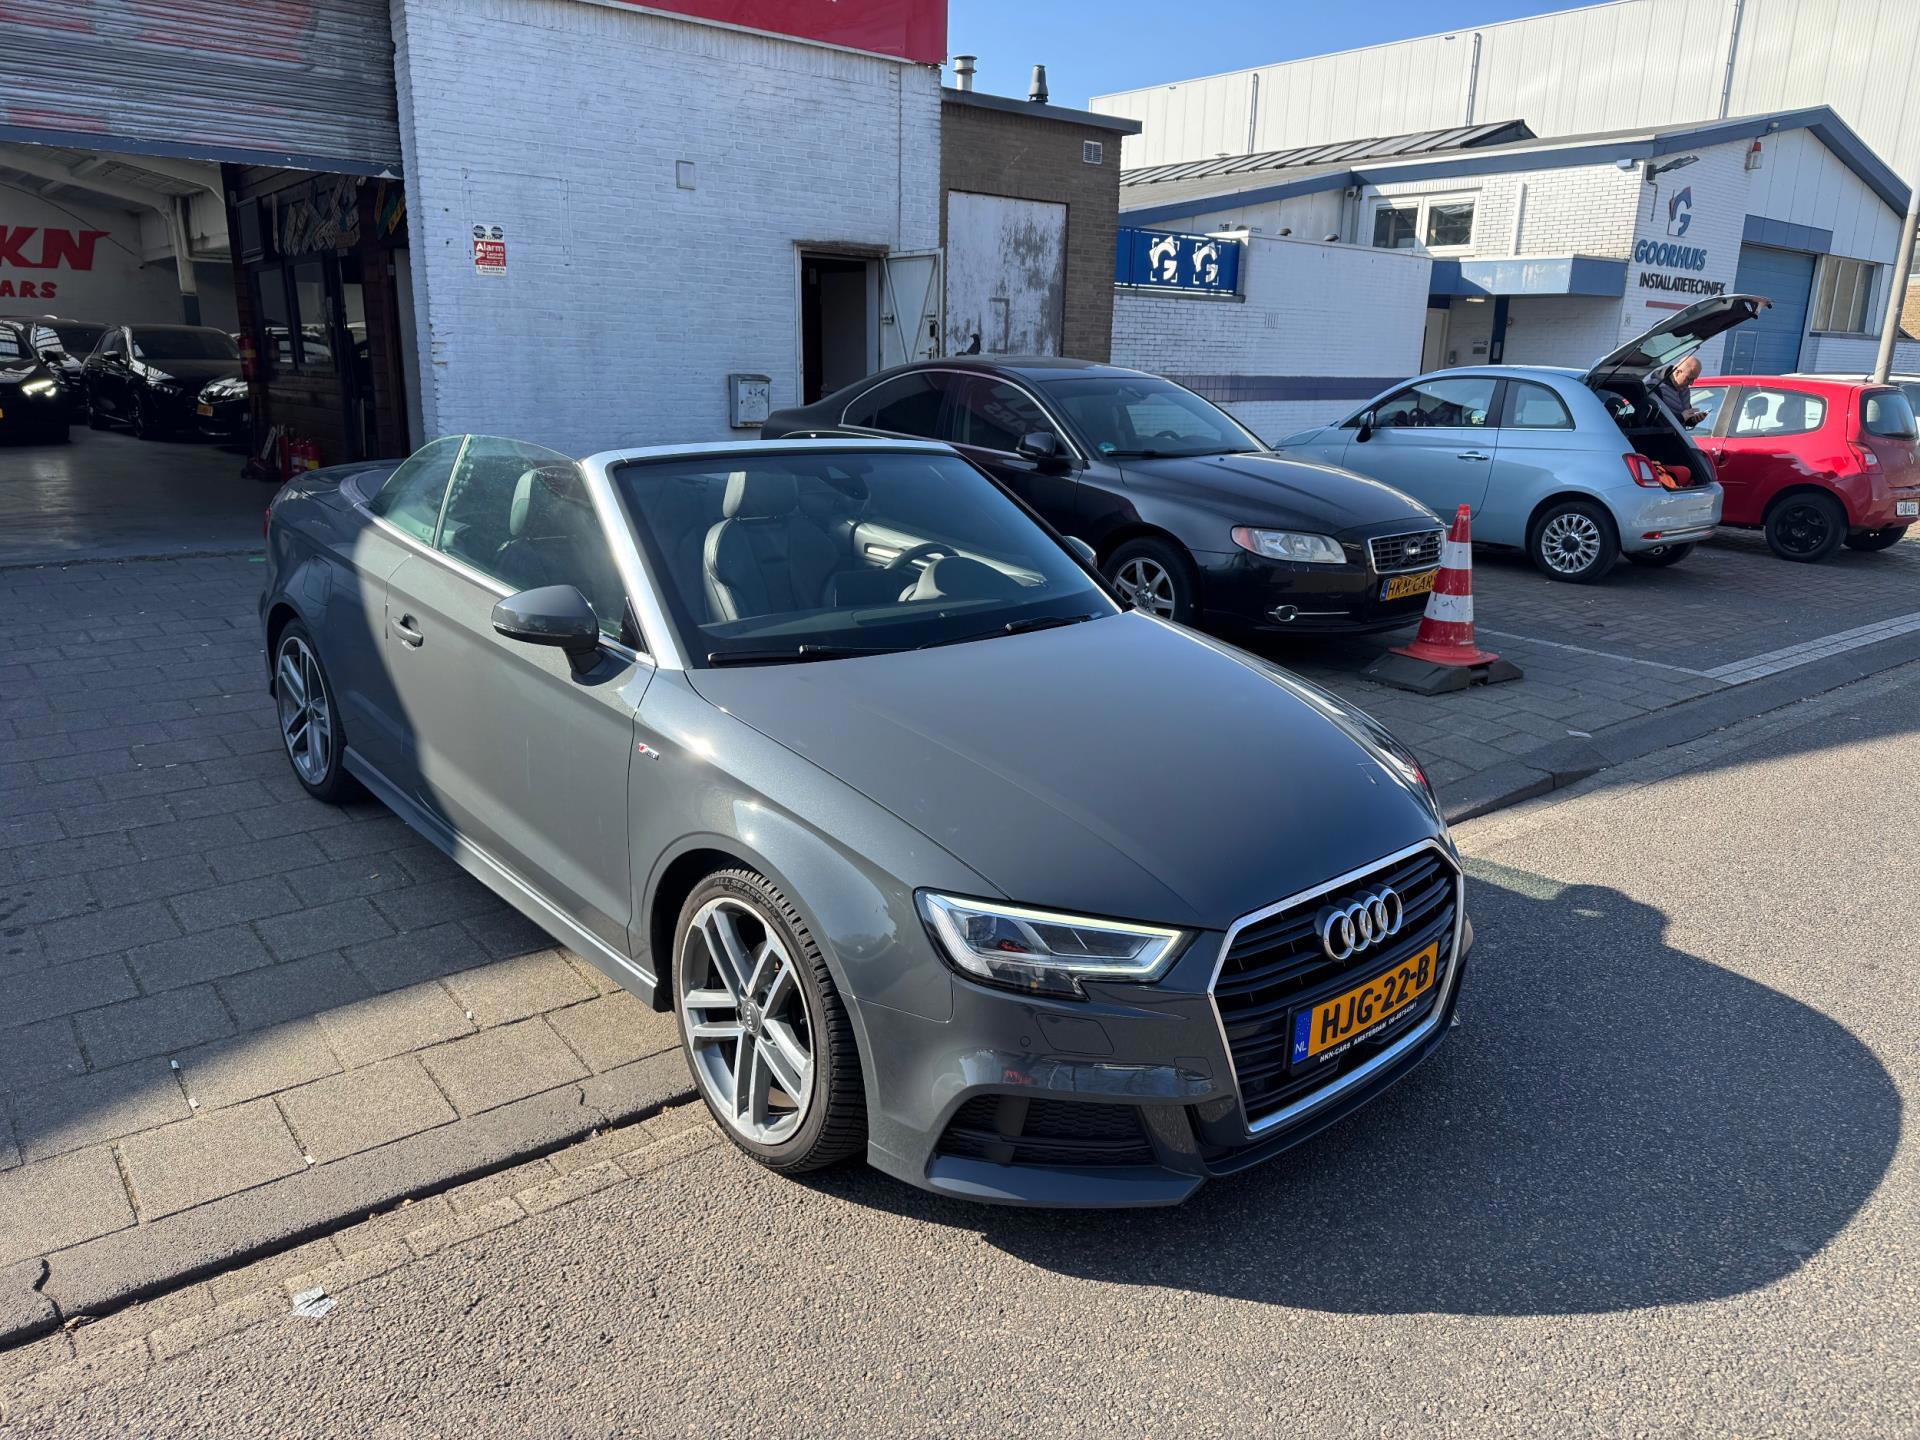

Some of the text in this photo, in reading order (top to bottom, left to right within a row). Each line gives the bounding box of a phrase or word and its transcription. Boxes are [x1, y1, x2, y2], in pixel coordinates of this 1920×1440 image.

[476, 242, 503, 252] Alarm
[1635, 239, 1707, 271] GOORHUIS
[0, 280, 57, 298] ARS
[1639, 272, 1726, 295] INSTALLATIETECHNIEK
[1295, 954, 1429, 1055] NL HJG-22-B
[1353, 1021, 1386, 1045] AMSTERDAM
